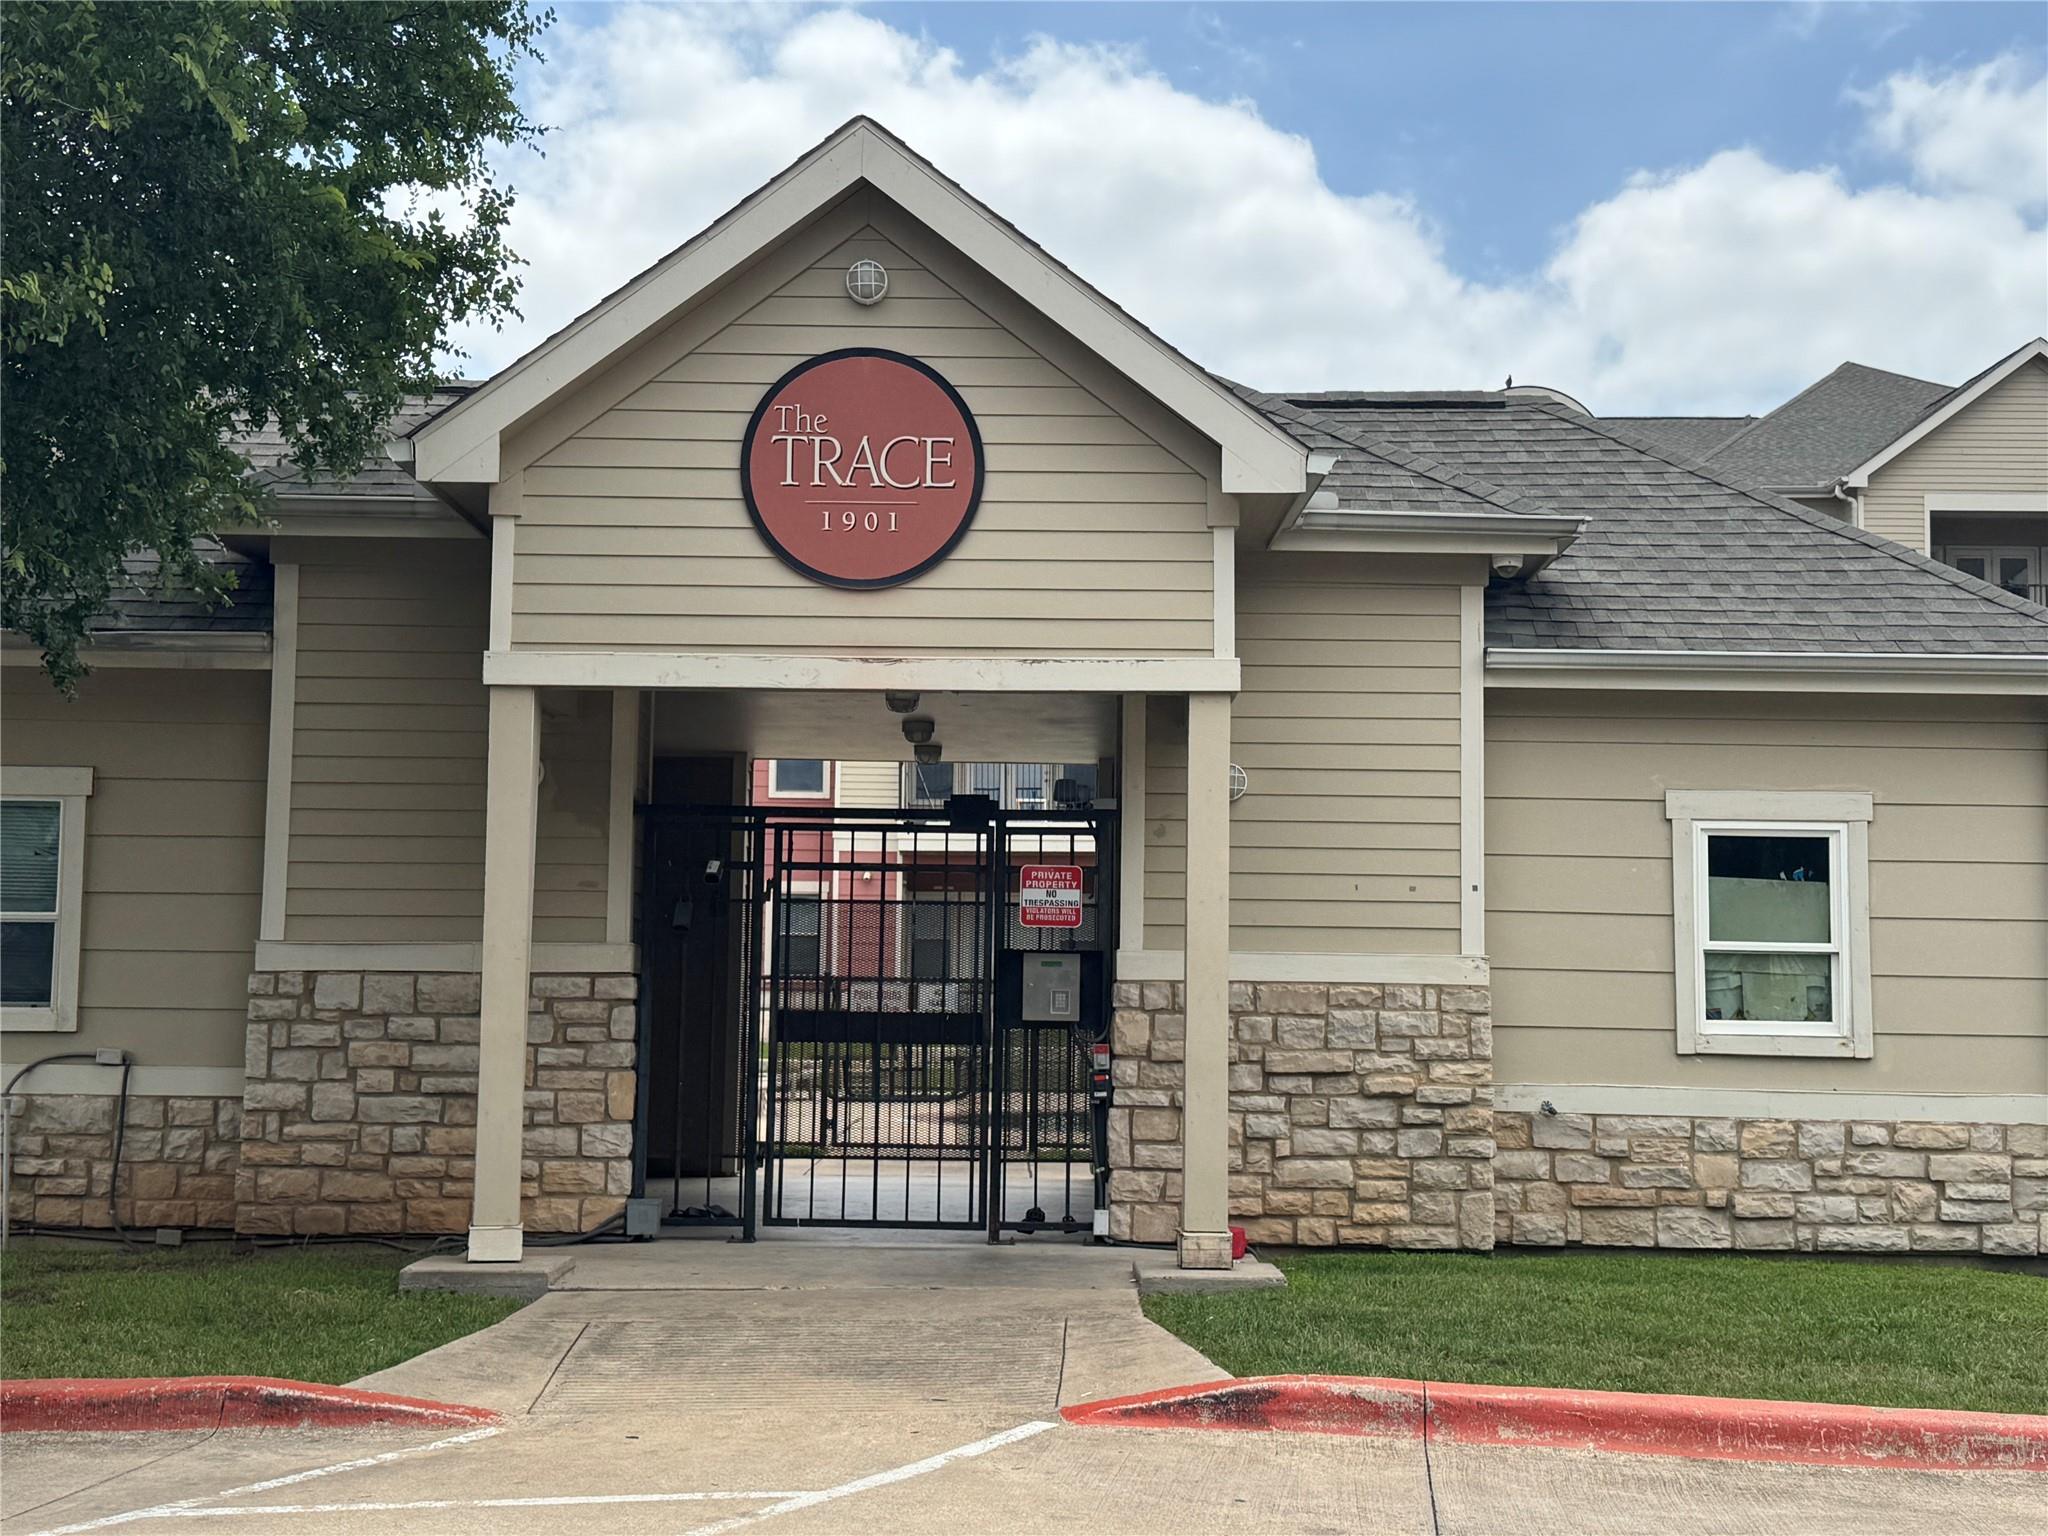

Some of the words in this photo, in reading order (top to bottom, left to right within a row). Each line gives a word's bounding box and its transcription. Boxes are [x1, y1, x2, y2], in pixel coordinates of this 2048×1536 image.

[773, 403, 829, 434] The
[770, 435, 956, 490] TRACE
[821, 511, 900, 532] 1901
[1031, 871, 1073, 880] PRIVATE
[1025, 880, 1078, 889] PROPERTY
[1045, 889, 1057, 898] NO
[1024, 899, 1079, 907] TRESPASSING
